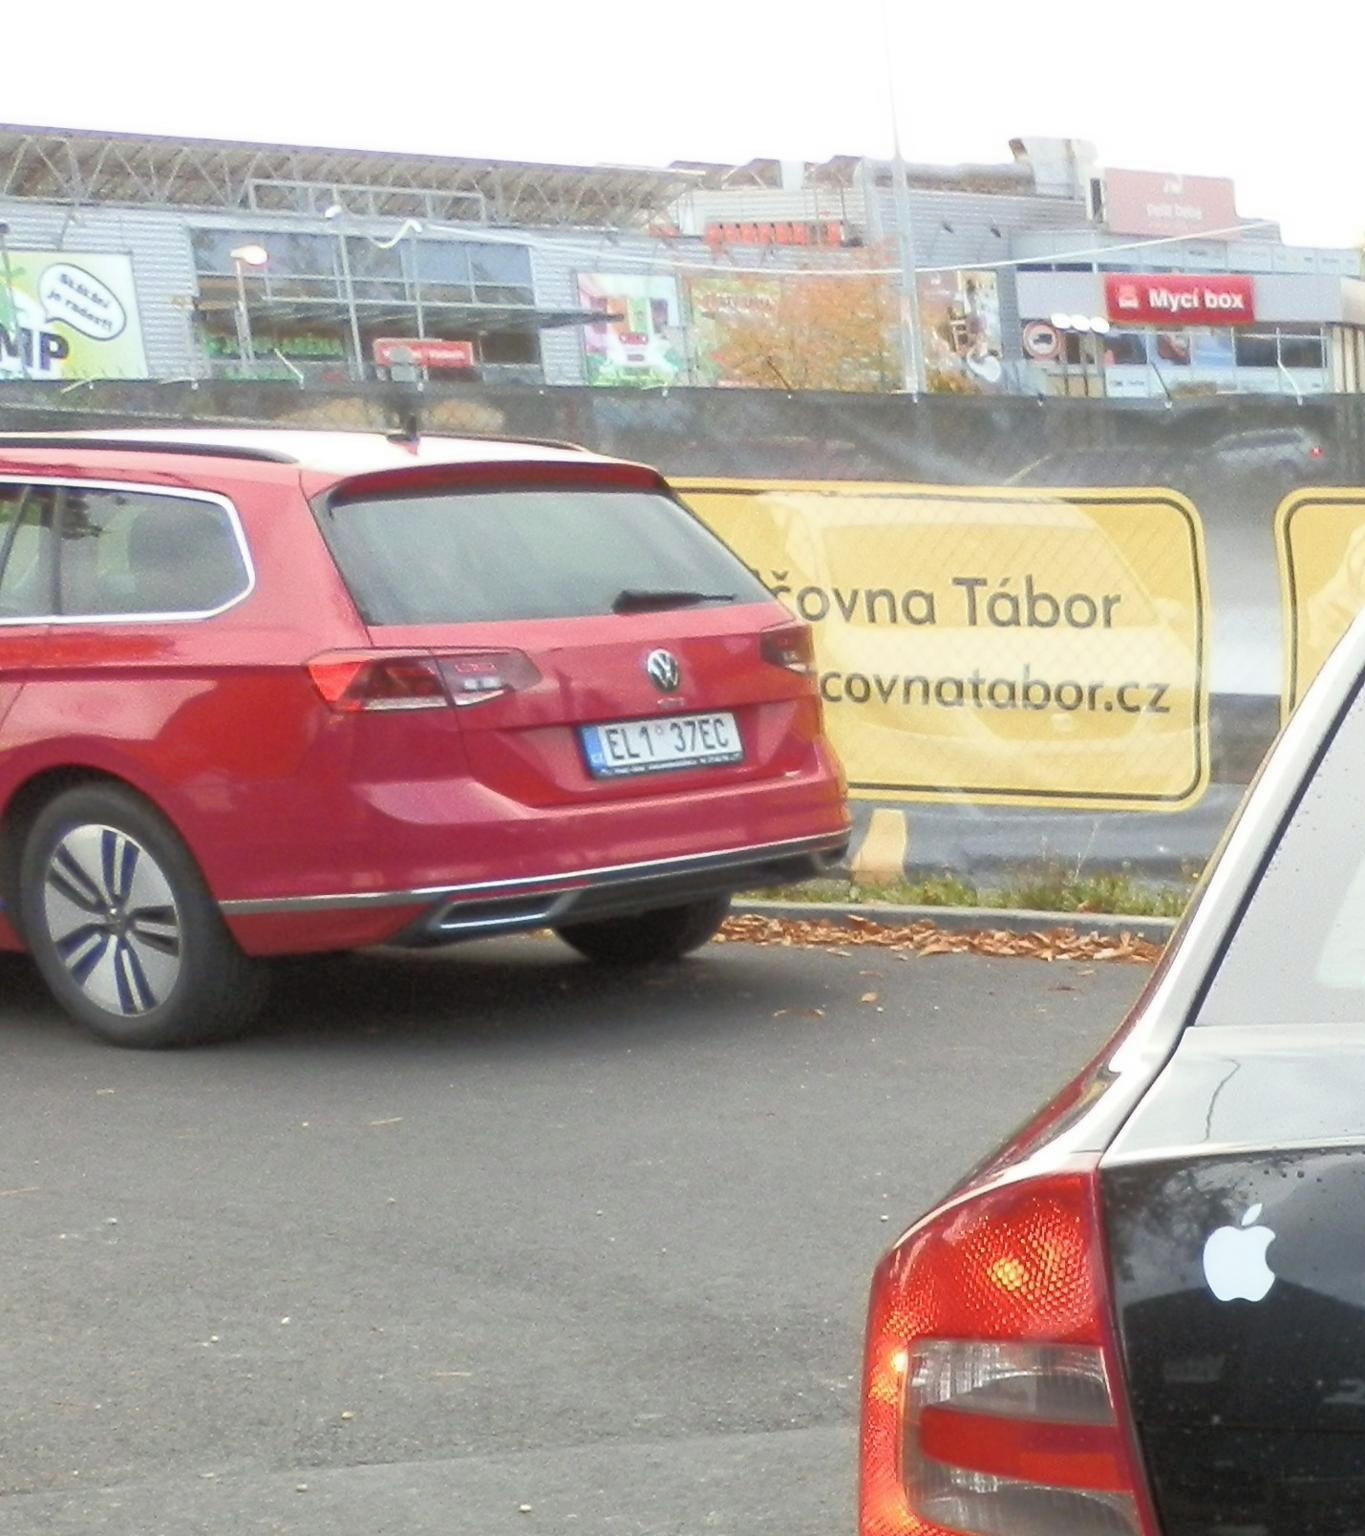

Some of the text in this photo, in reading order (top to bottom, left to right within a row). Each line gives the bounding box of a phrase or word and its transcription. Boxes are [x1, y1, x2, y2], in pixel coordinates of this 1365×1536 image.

[1149, 288, 1244, 312] Mycí box
[951, 574, 1122, 629] Tábor
[819, 664, 1171, 714] covnatabor.cz
[604, 718, 729, 760] EL1 37EC
